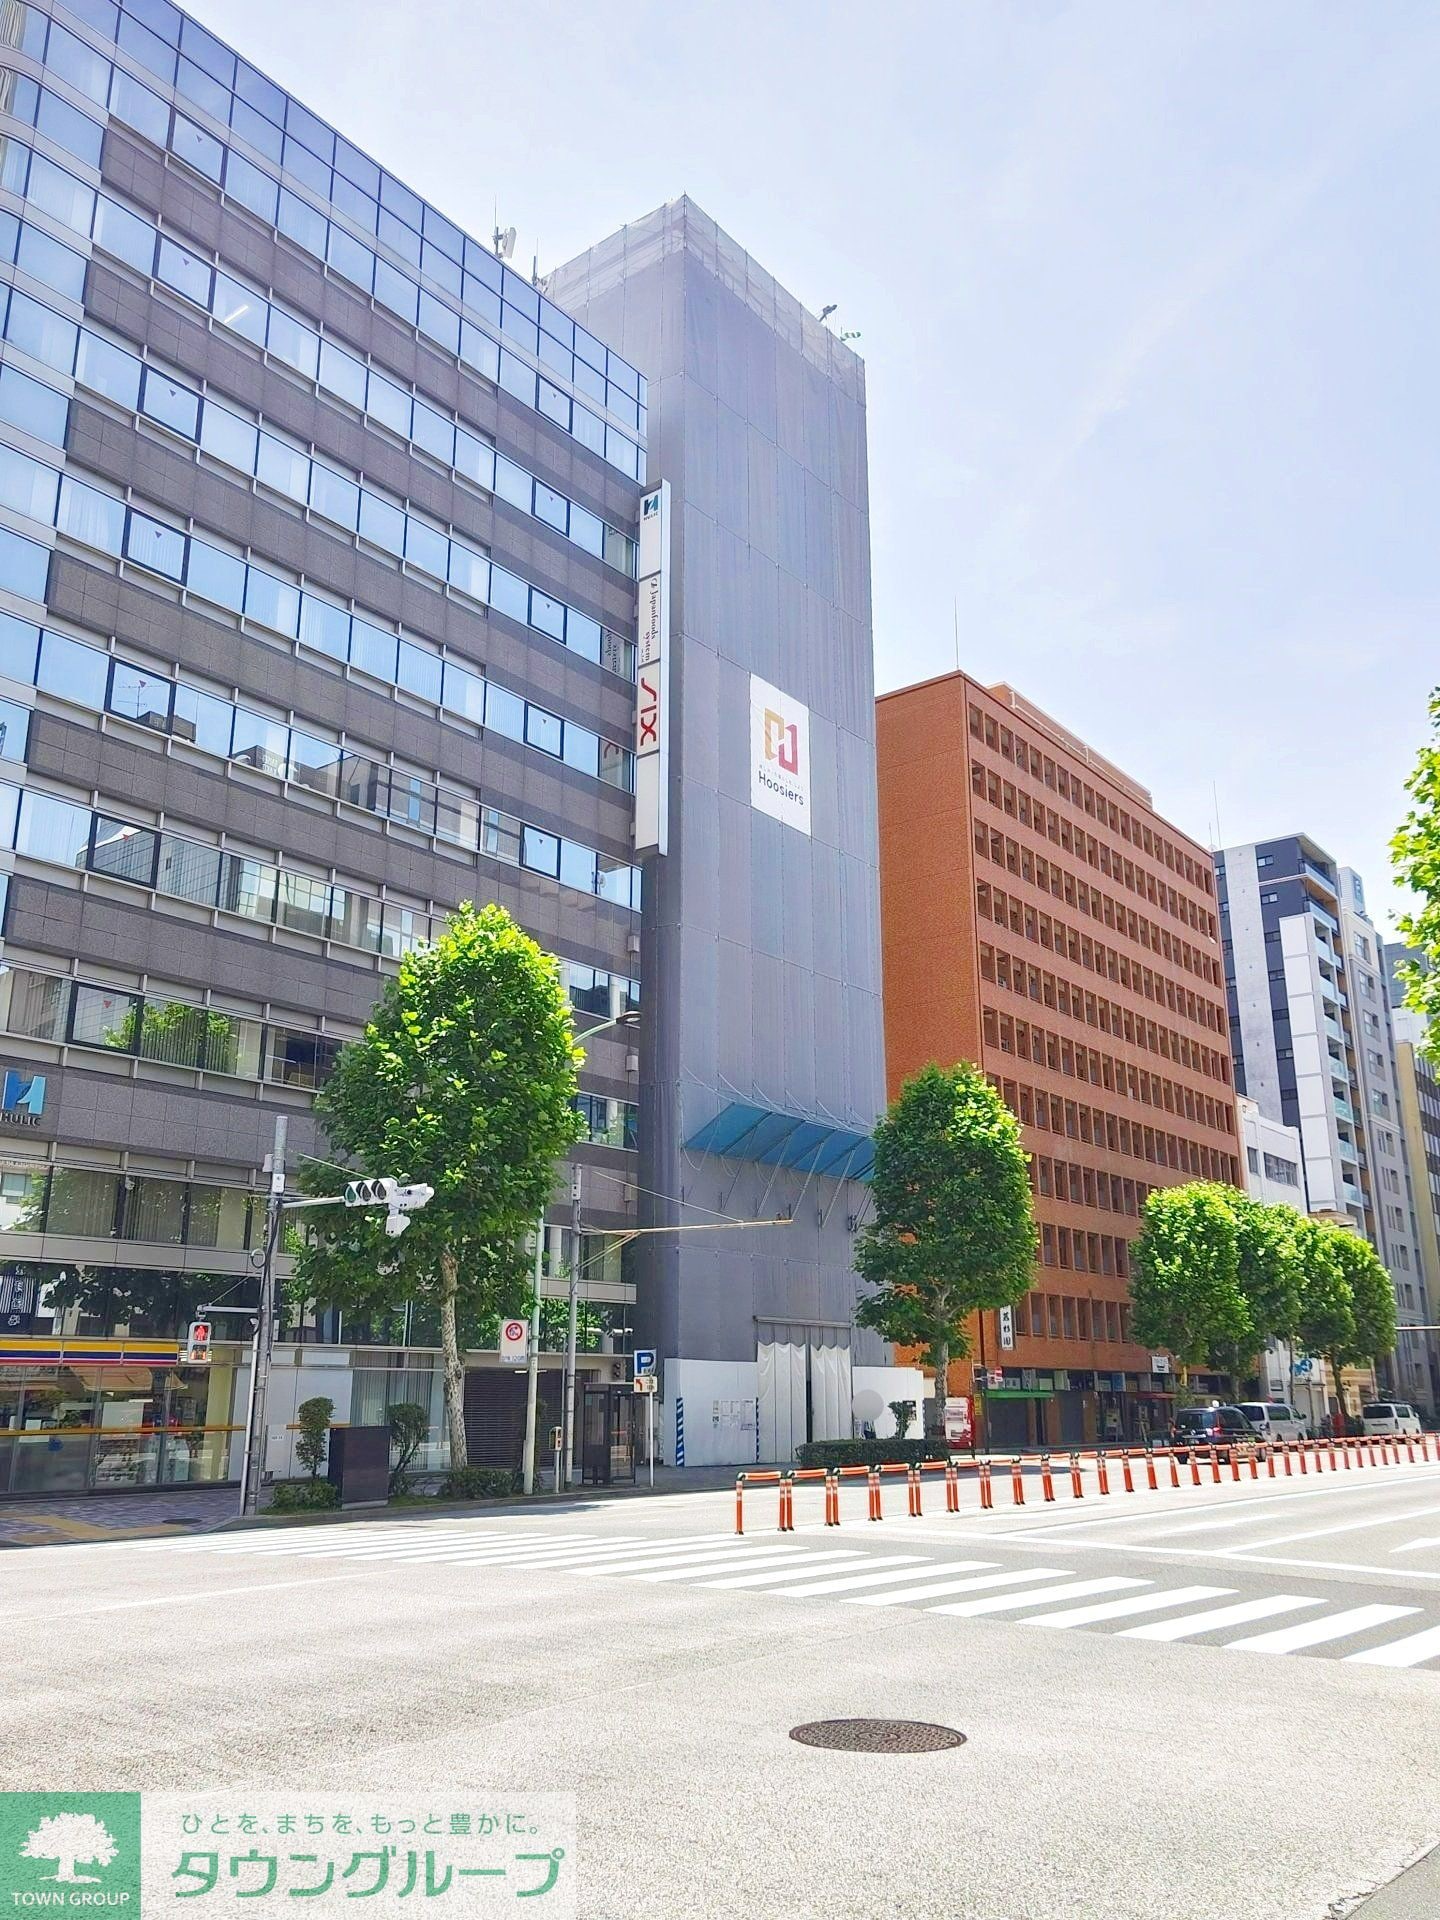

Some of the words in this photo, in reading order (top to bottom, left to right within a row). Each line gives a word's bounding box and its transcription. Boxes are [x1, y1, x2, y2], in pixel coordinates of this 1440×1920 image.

[641, 677, 657, 747] SIX
[758, 770, 804, 806] Hoosiers
[0, 1112, 41, 1127] HULIC
[636, 1352, 655, 1375] P
